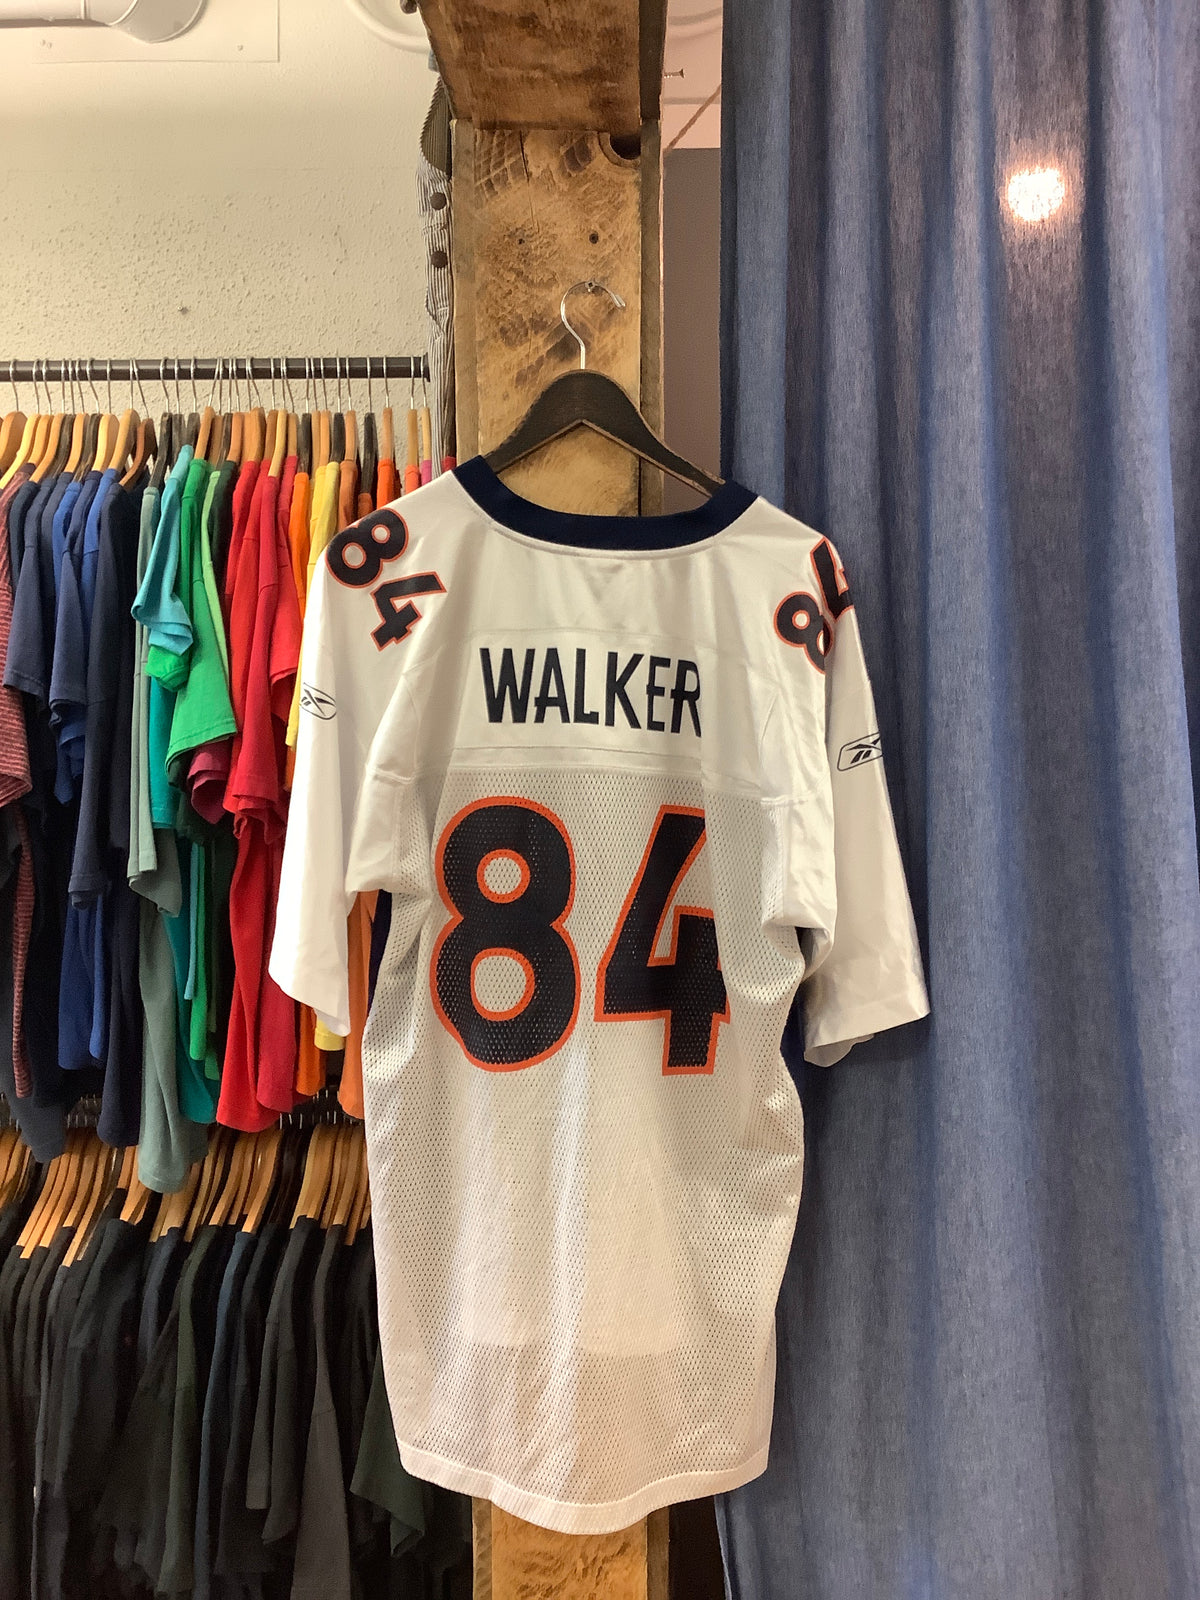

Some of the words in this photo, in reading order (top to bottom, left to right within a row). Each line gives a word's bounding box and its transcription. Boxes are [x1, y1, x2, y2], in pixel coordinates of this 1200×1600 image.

[325, 507, 447, 651] 84
[479, 648, 702, 738] WALKER
[429, 795, 731, 1076] 84
